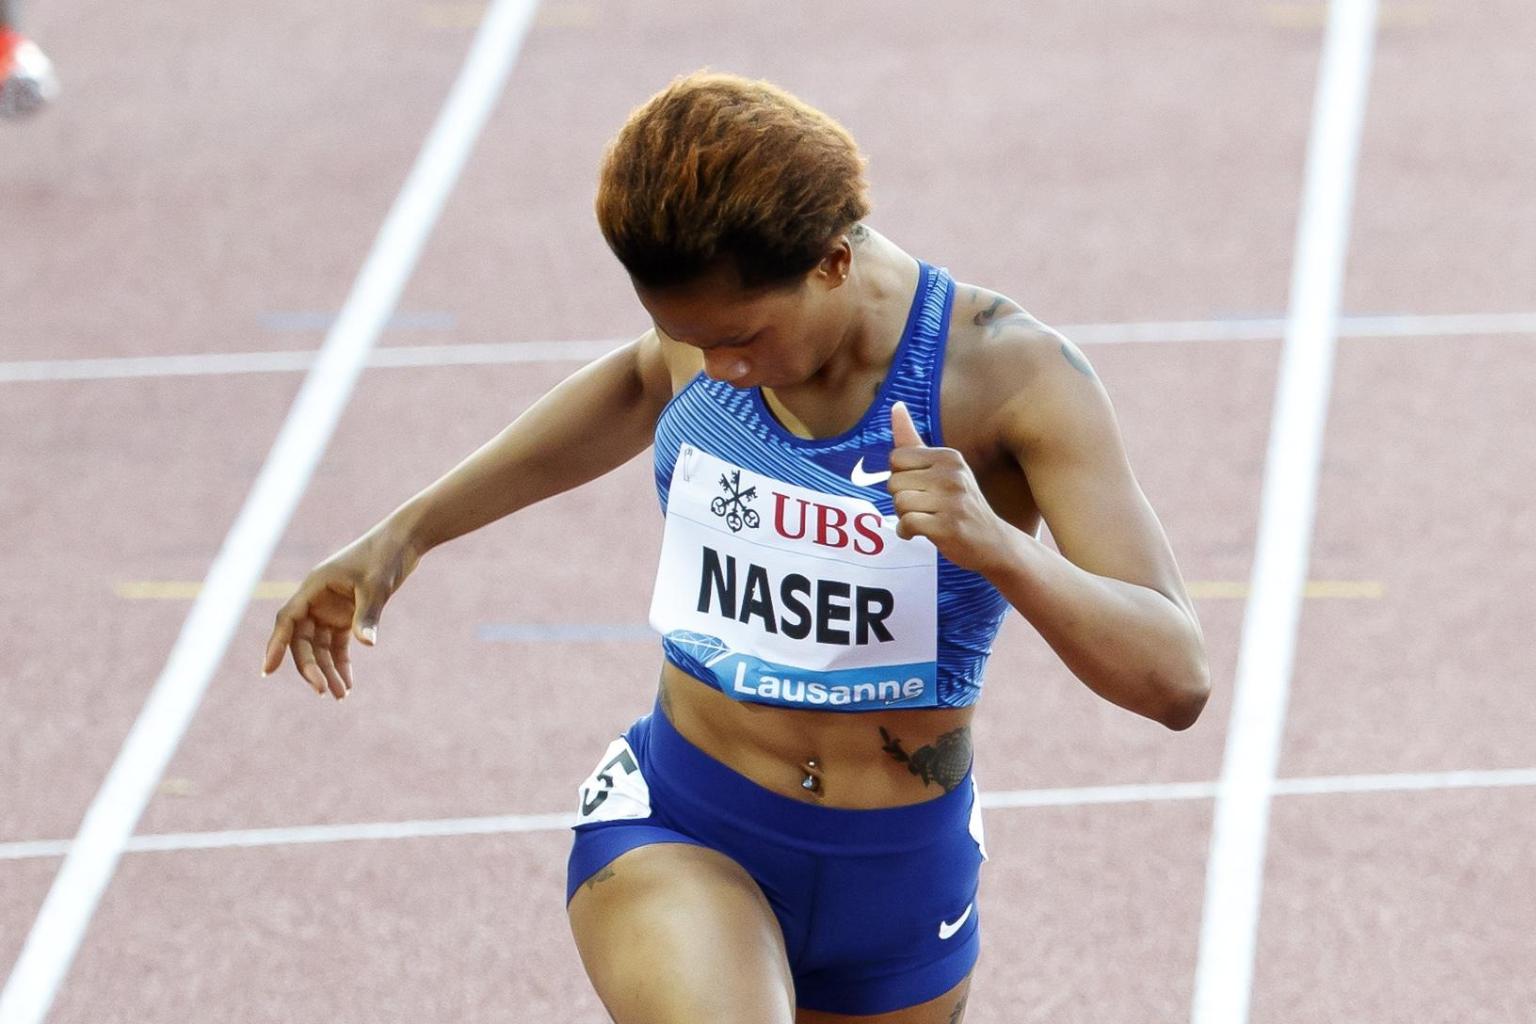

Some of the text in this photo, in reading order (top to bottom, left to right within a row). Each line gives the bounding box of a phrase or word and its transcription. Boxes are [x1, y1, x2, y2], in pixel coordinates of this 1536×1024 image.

[772, 491, 885, 556] UBS
[696, 546, 895, 647] NASER
[733, 661, 924, 705] Lausanne
